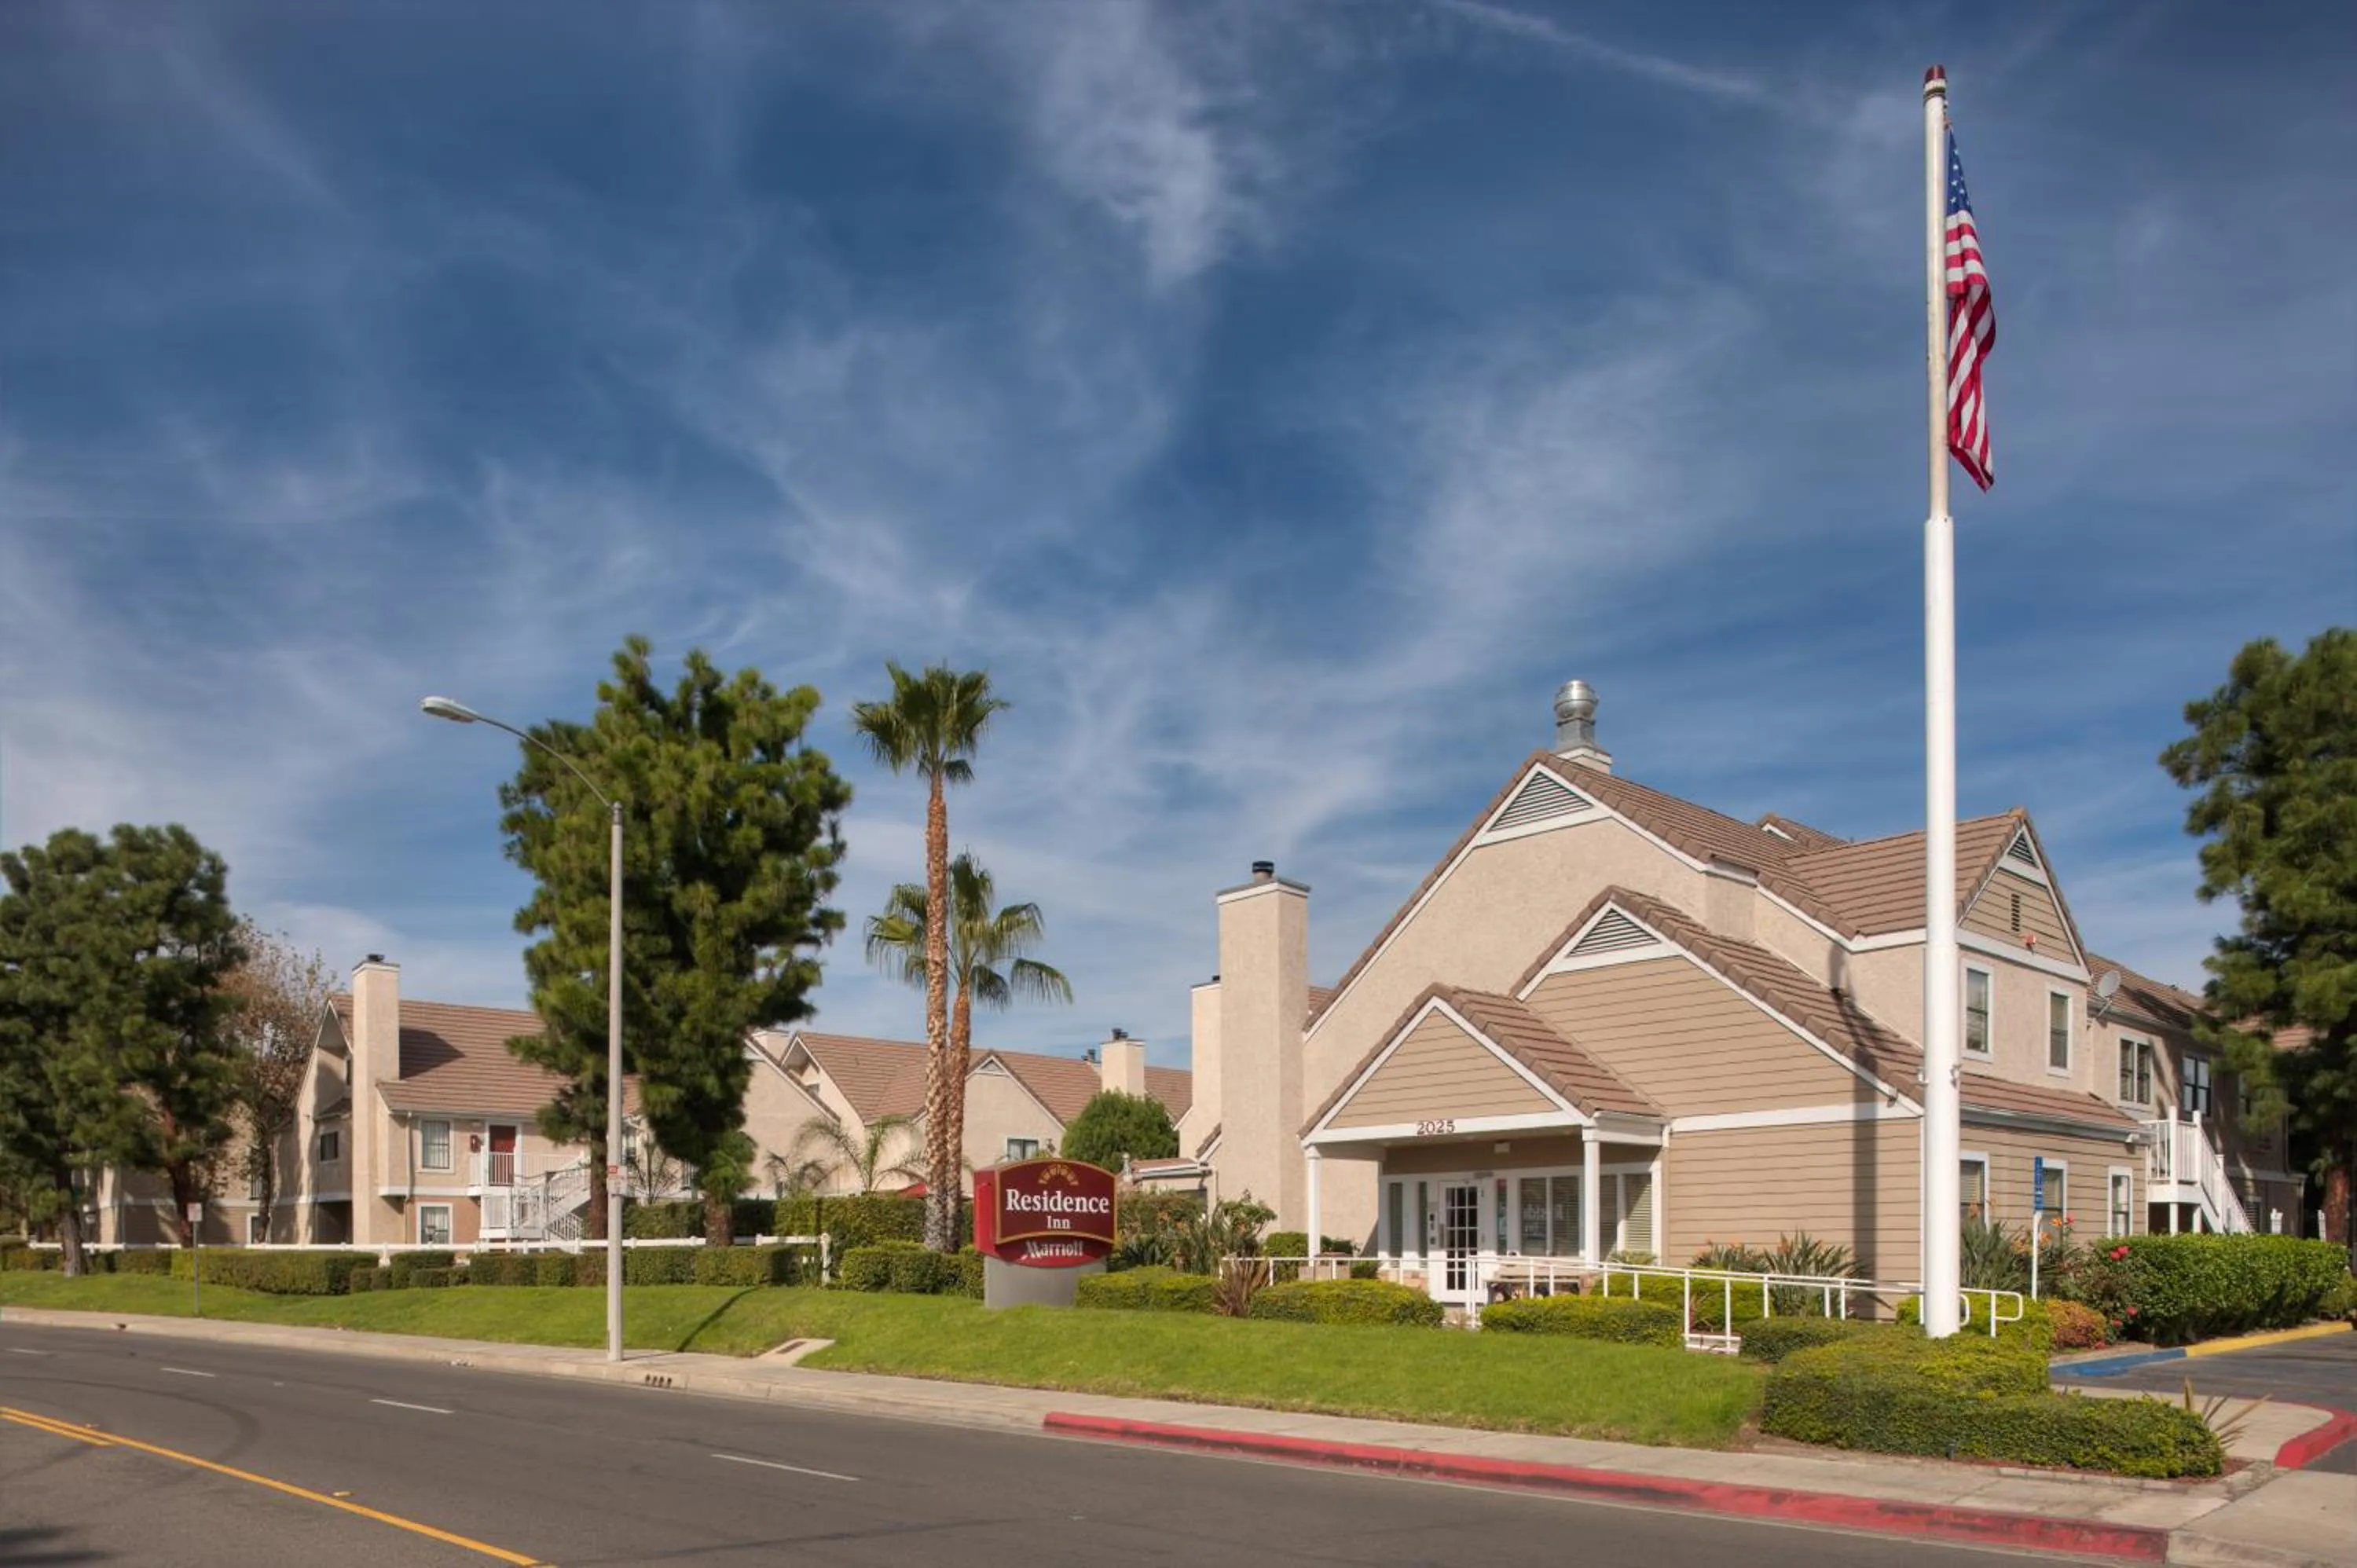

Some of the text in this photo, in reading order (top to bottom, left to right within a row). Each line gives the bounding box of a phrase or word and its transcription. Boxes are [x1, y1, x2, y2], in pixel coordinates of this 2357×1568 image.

[1417, 1119, 1455, 1134] 2025
[1006, 1189, 1109, 1213] Residence
[1047, 1215, 1071, 1229] Inn
